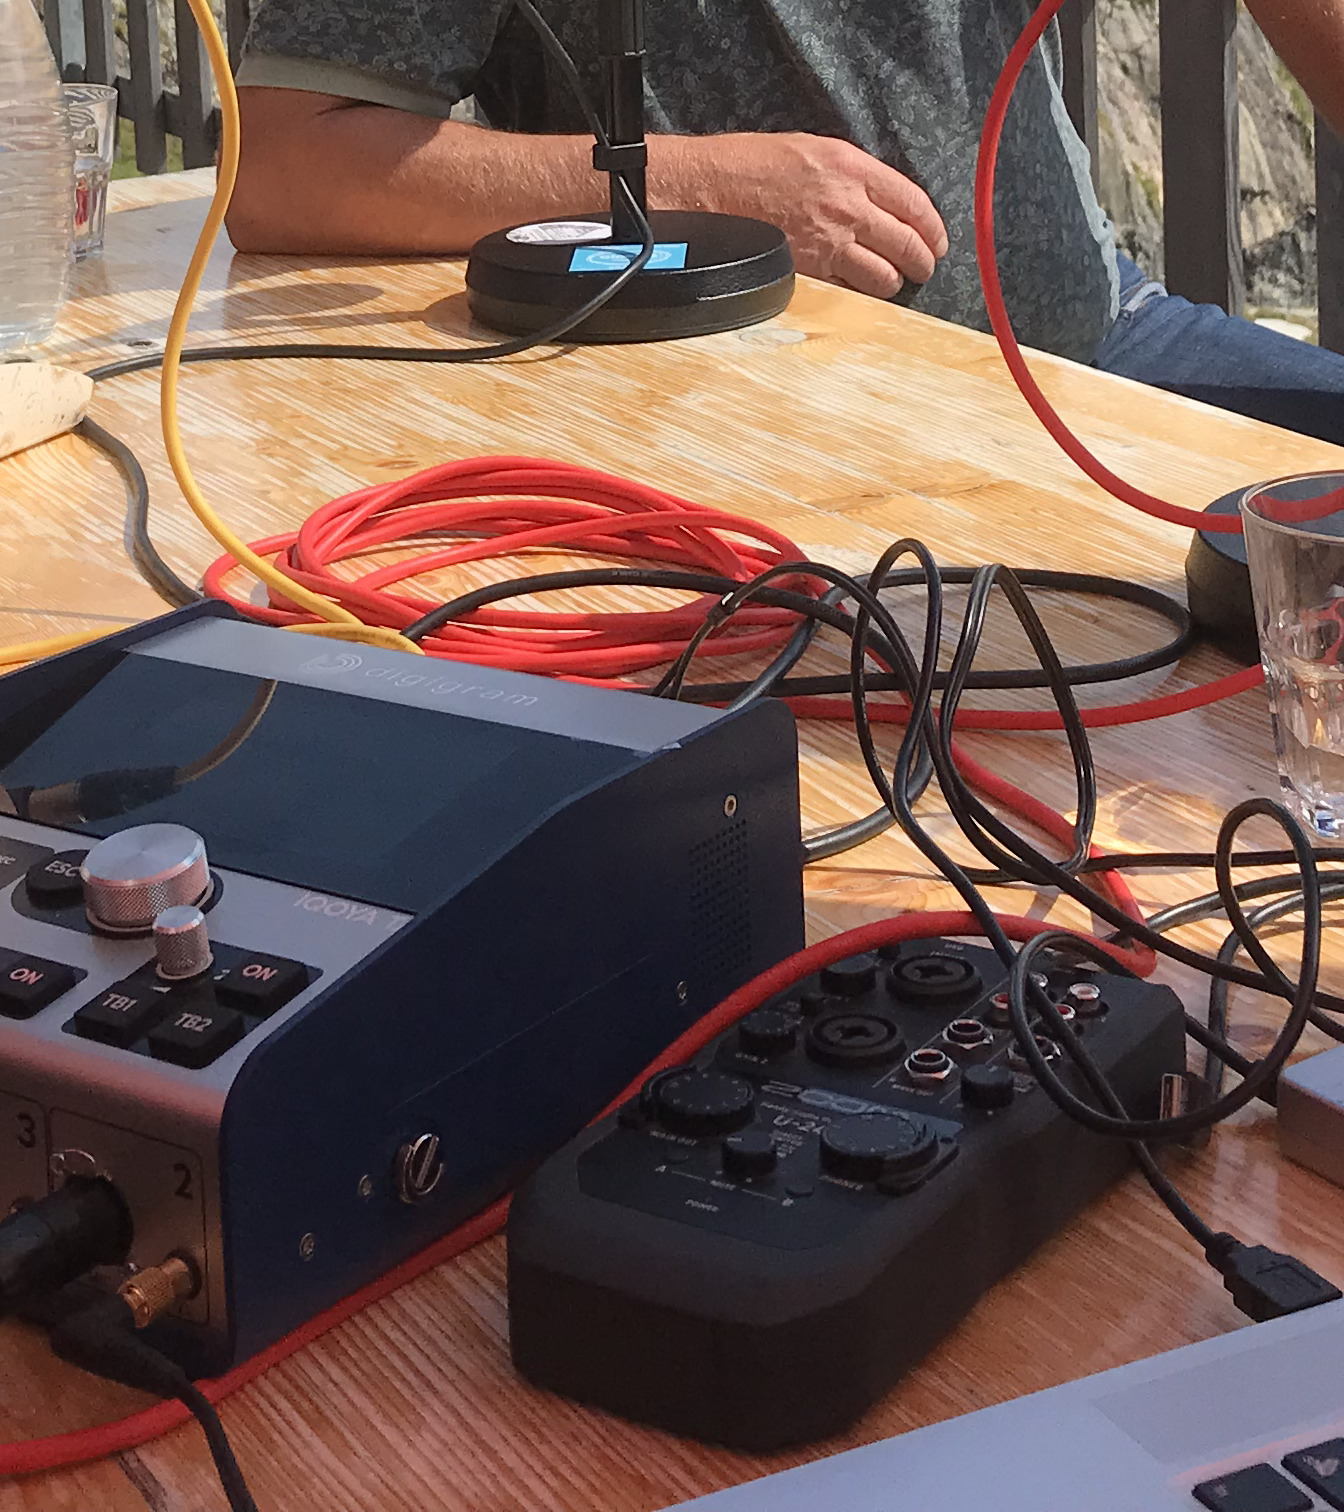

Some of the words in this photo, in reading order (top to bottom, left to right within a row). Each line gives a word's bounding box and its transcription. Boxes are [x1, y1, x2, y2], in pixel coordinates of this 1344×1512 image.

[365, 666, 539, 707] digigram
[44, 860, 81, 877] ESC
[9, 967, 45, 985] ON
[242, 964, 278, 982] ON
[102, 993, 137, 1012] TB1
[174, 1012, 213, 1033] TB2
[17, 1113, 37, 1148] 3
[173, 1163, 194, 1201] 2
